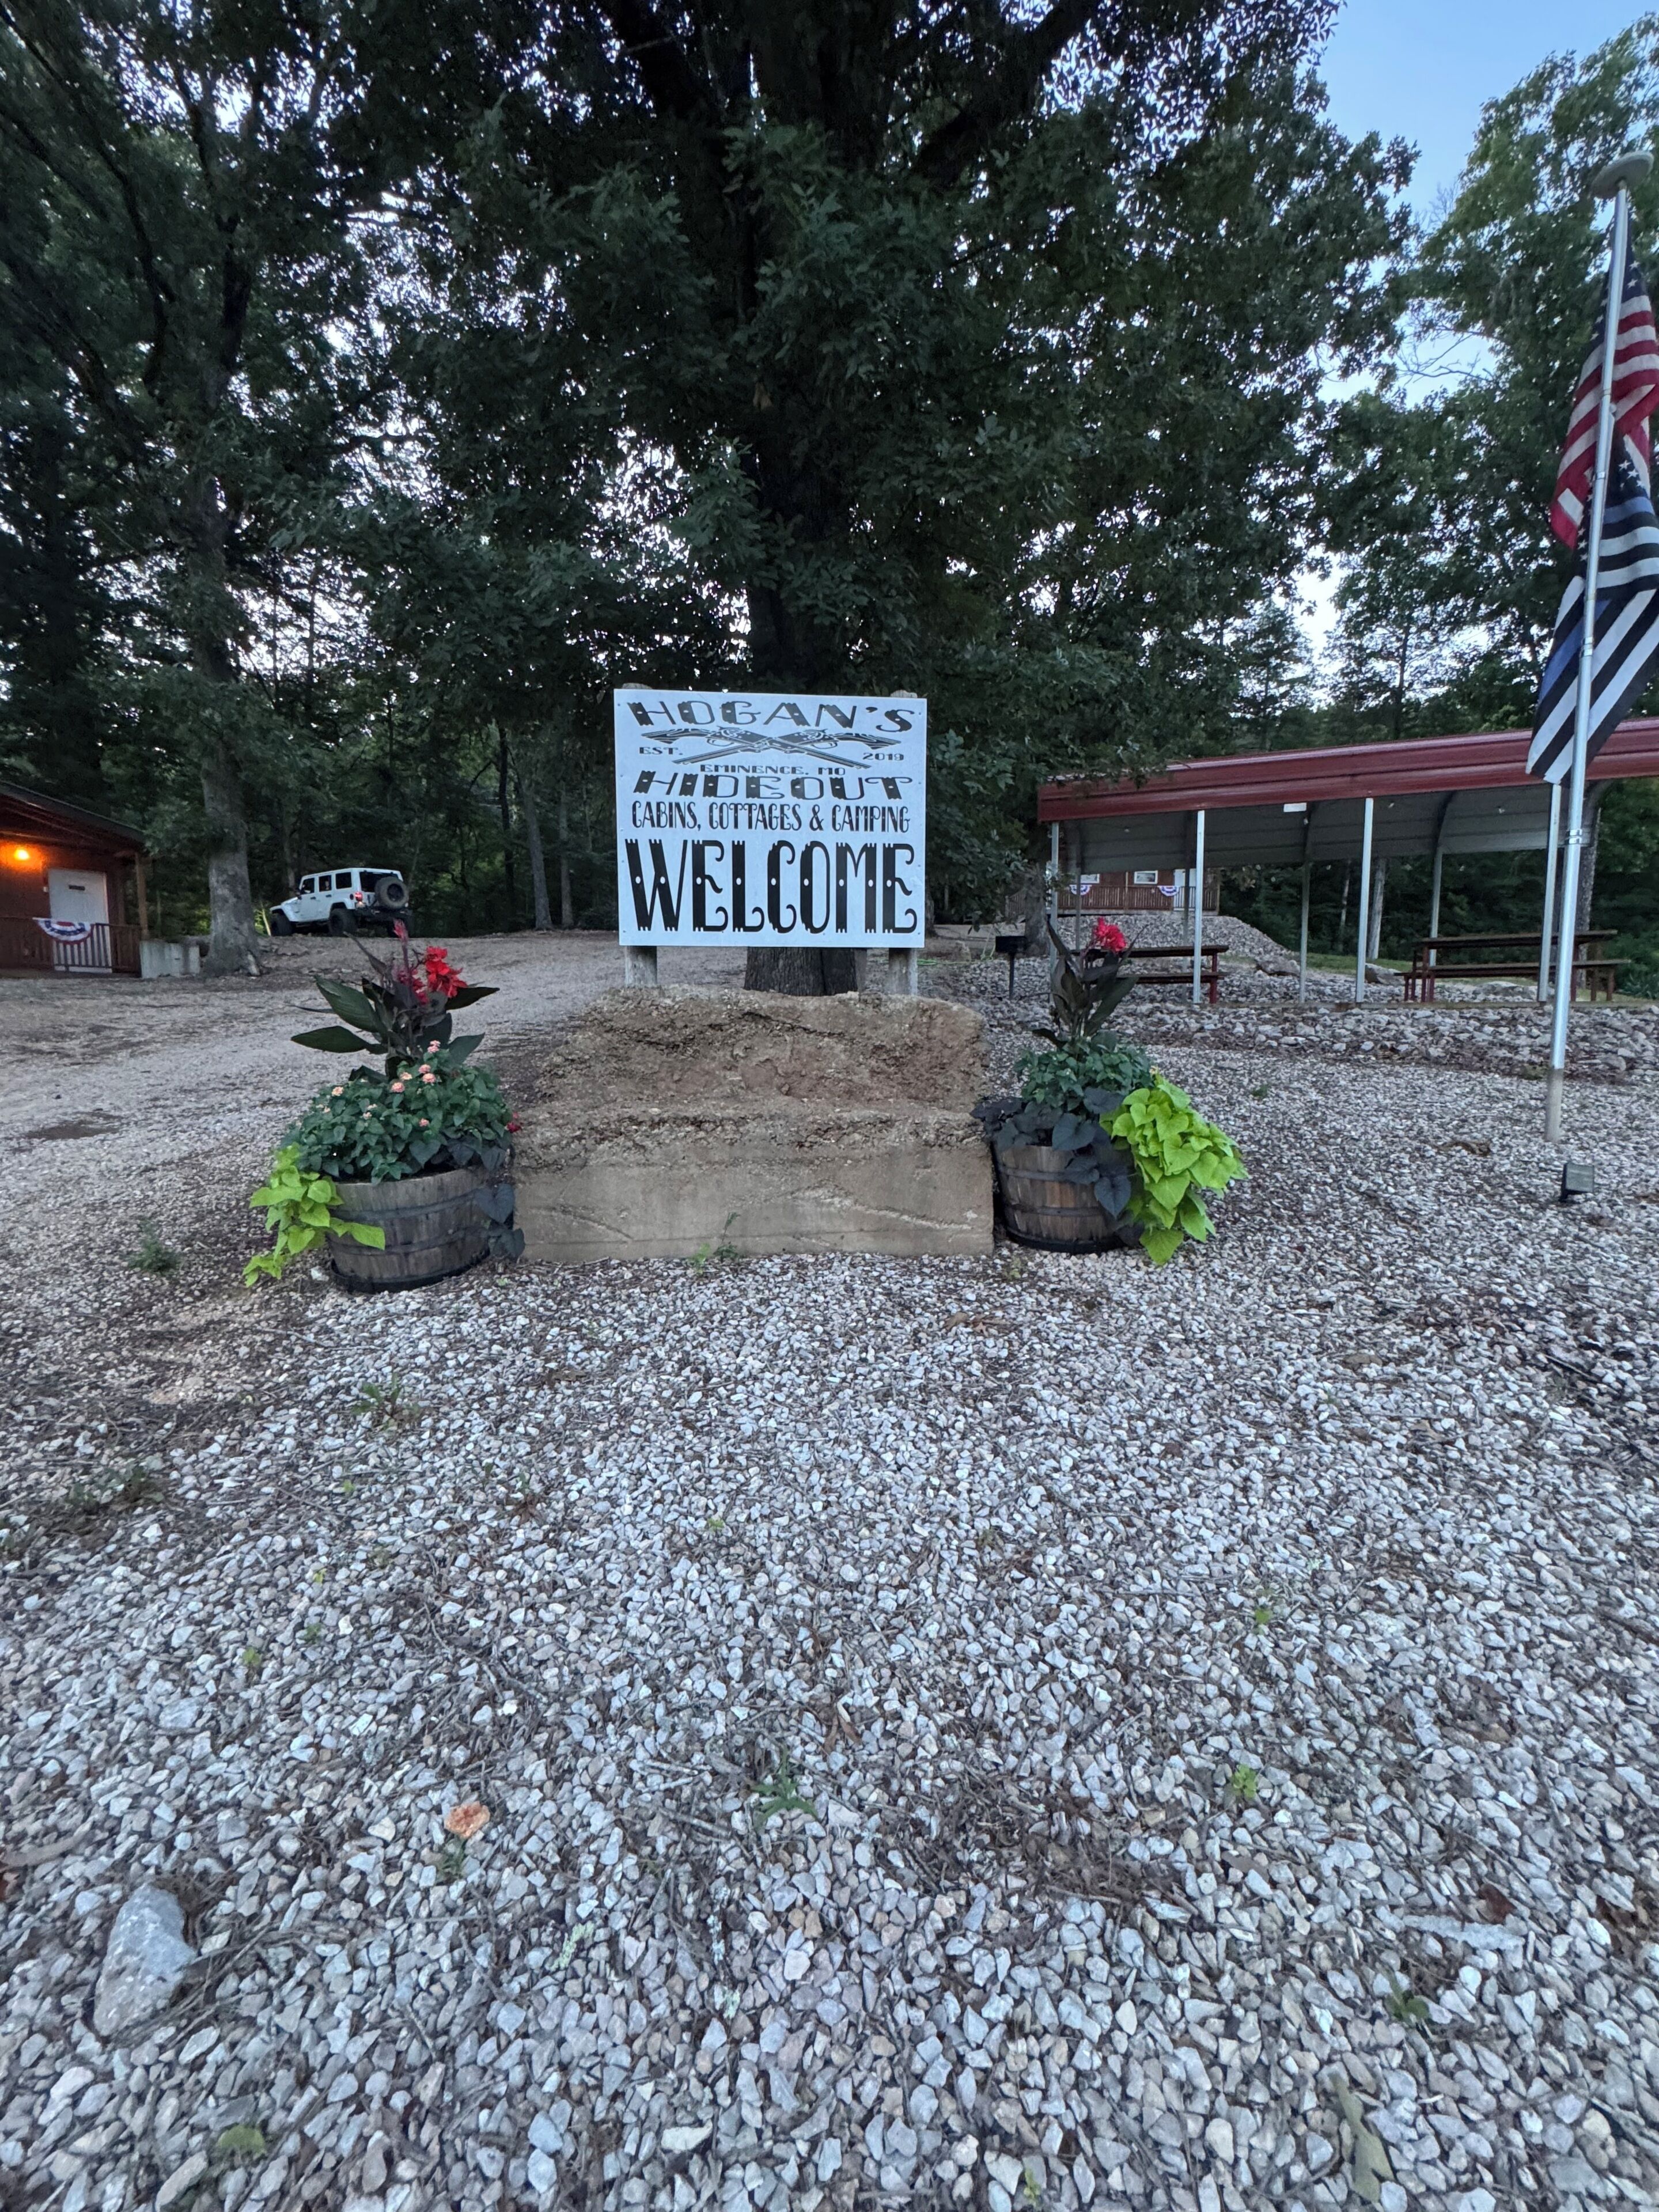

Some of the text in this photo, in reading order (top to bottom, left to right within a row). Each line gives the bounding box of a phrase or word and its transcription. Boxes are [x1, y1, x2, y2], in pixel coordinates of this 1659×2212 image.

[627, 700, 915, 733] HOGAN'S
[639, 747, 684, 756] EST.
[862, 752, 904, 762] 2019
[633, 770, 913, 800] HIDEOUT
[818, 767, 846, 776] MO
[632, 801, 911, 833] CABINS, COTTAGES & CAMPING
[624, 838, 918, 934] WELCOME
